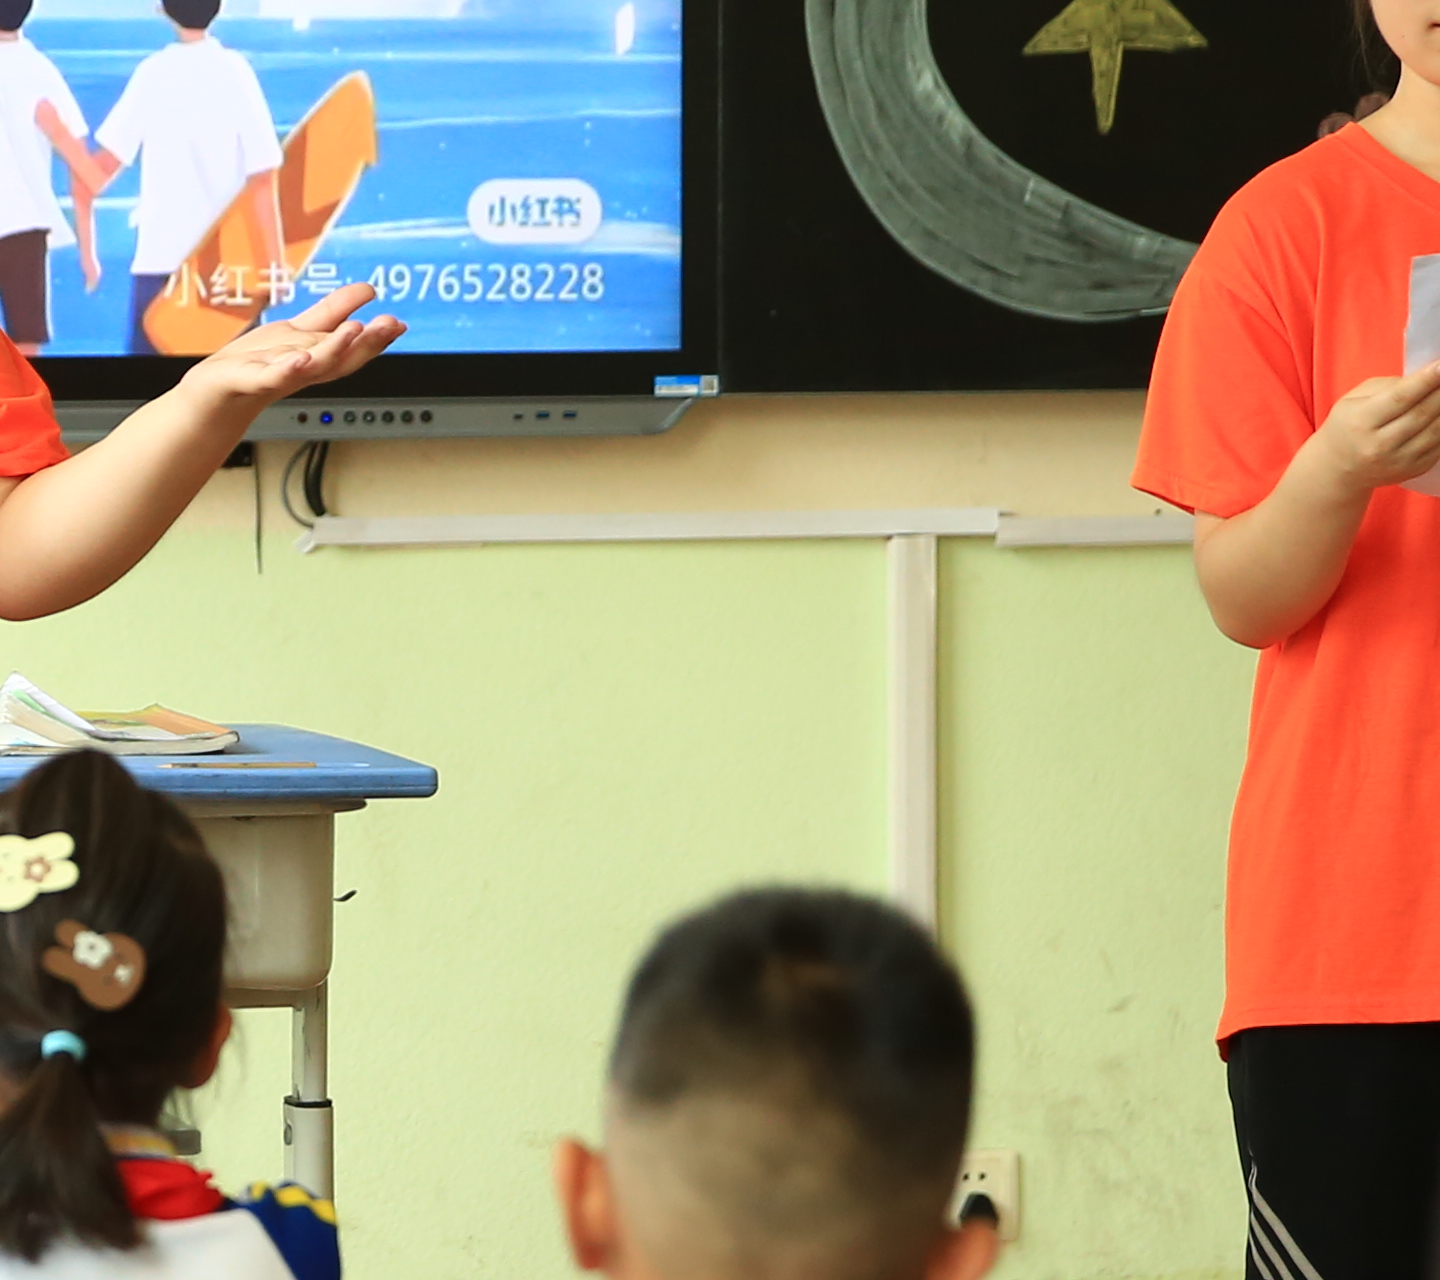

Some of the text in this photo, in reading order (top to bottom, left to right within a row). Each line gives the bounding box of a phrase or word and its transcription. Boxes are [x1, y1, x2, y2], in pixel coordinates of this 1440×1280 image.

[487, 195, 582, 228] 小红书
[366, 262, 606, 303] 4976528228
